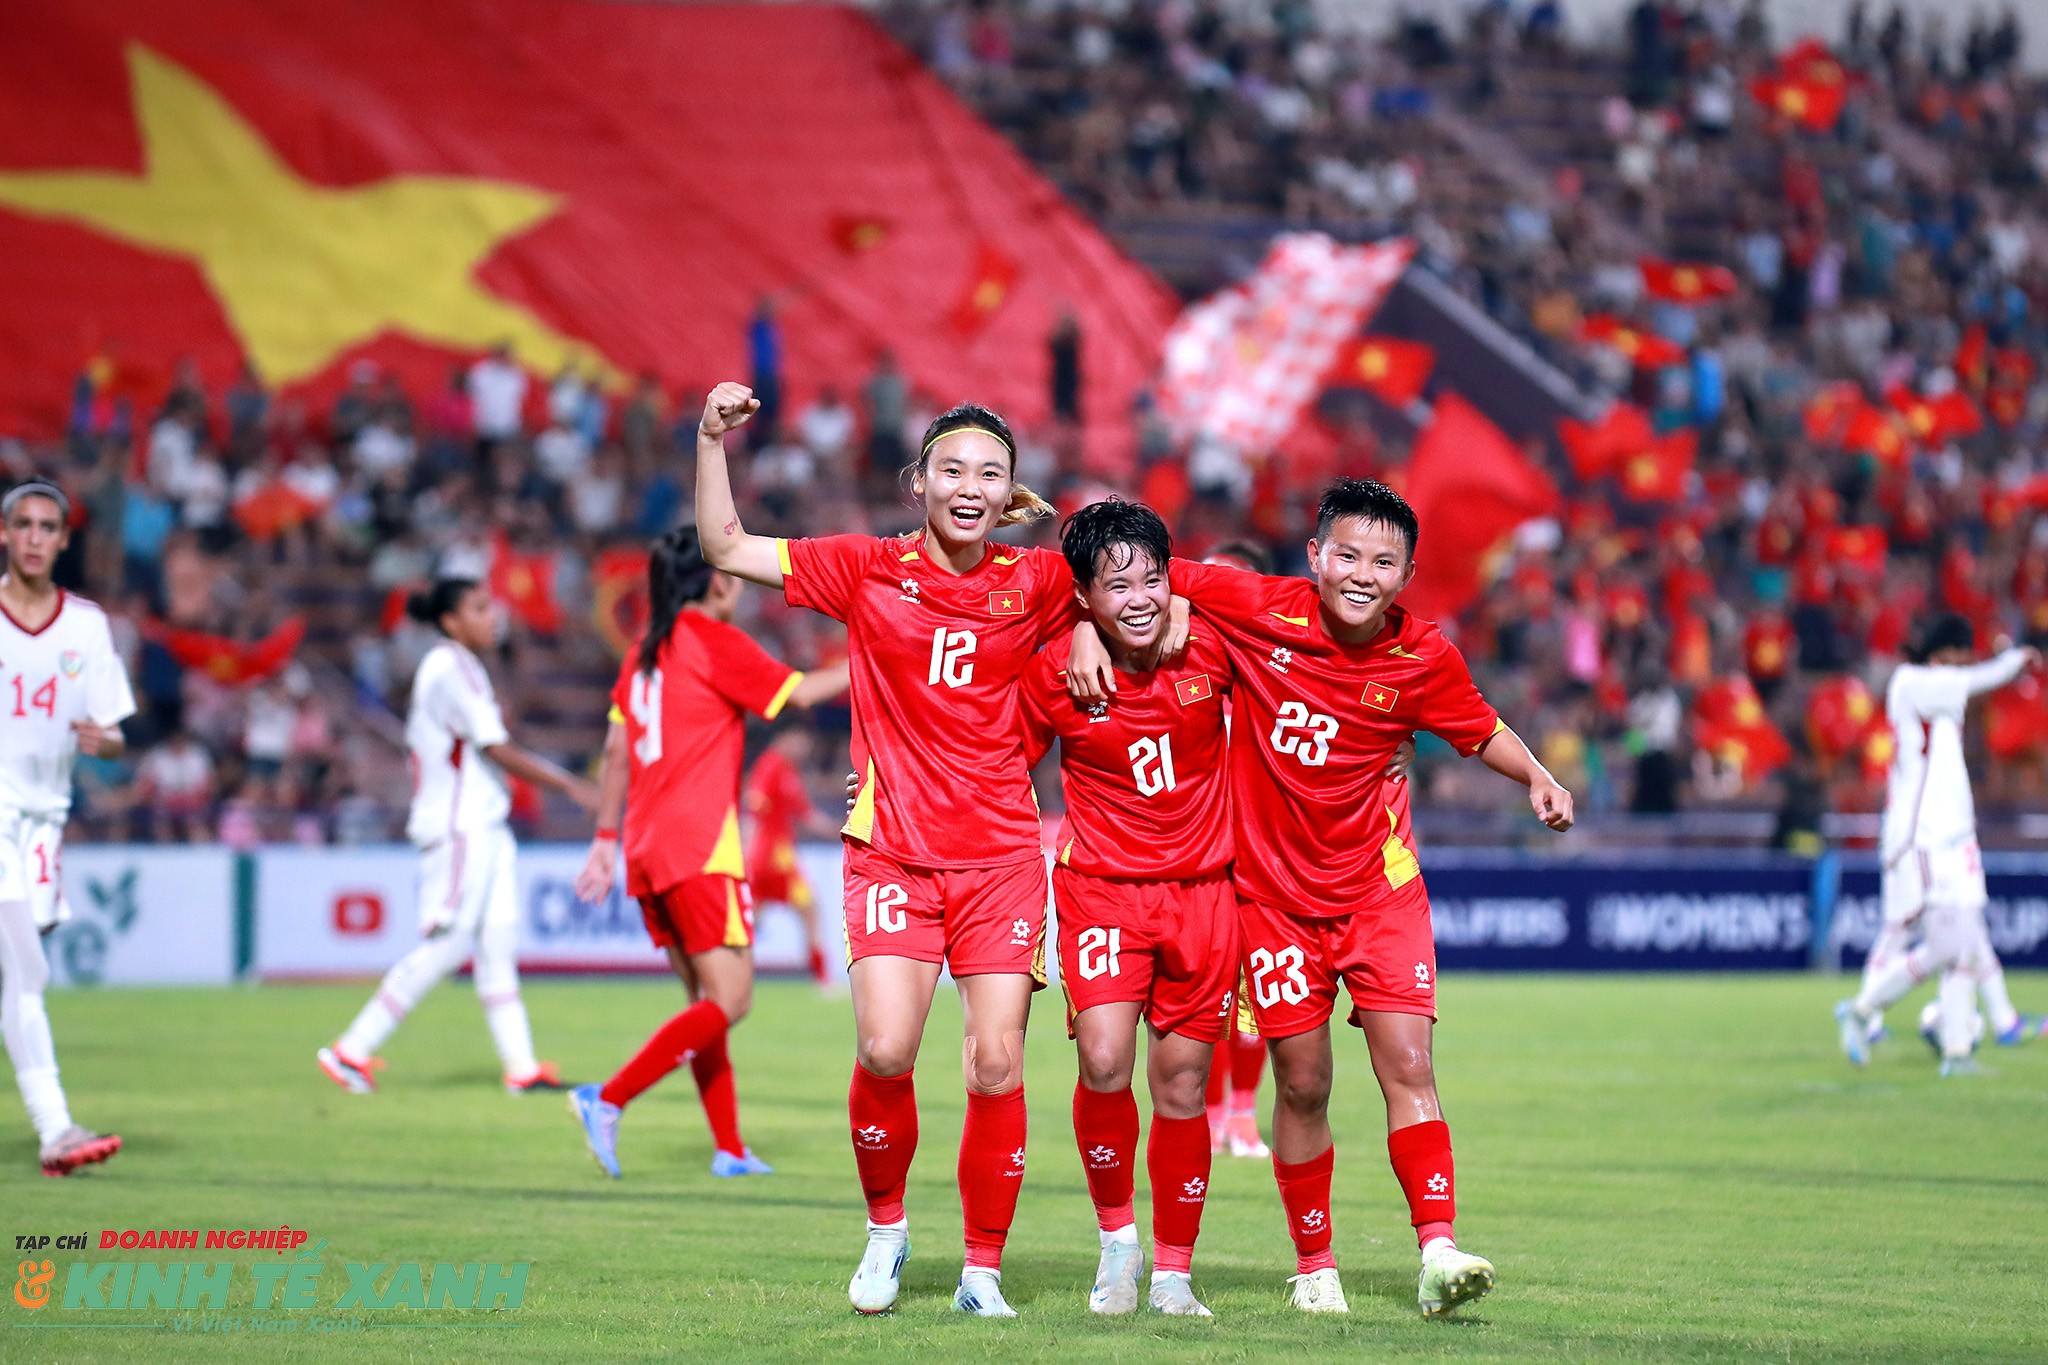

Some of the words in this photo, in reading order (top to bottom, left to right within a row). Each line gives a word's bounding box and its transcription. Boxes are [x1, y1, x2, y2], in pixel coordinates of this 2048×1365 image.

[928, 626, 978, 689] 12
[11, 672, 57, 719] 14
[629, 667, 664, 767] 9
[1127, 732, 1177, 798] 21
[1269, 700, 1340, 767] 23
[34, 842, 51, 884] 1
[865, 882, 909, 936] 12
[1077, 925, 1122, 982] 21
[1249, 944, 1311, 1010] 23
